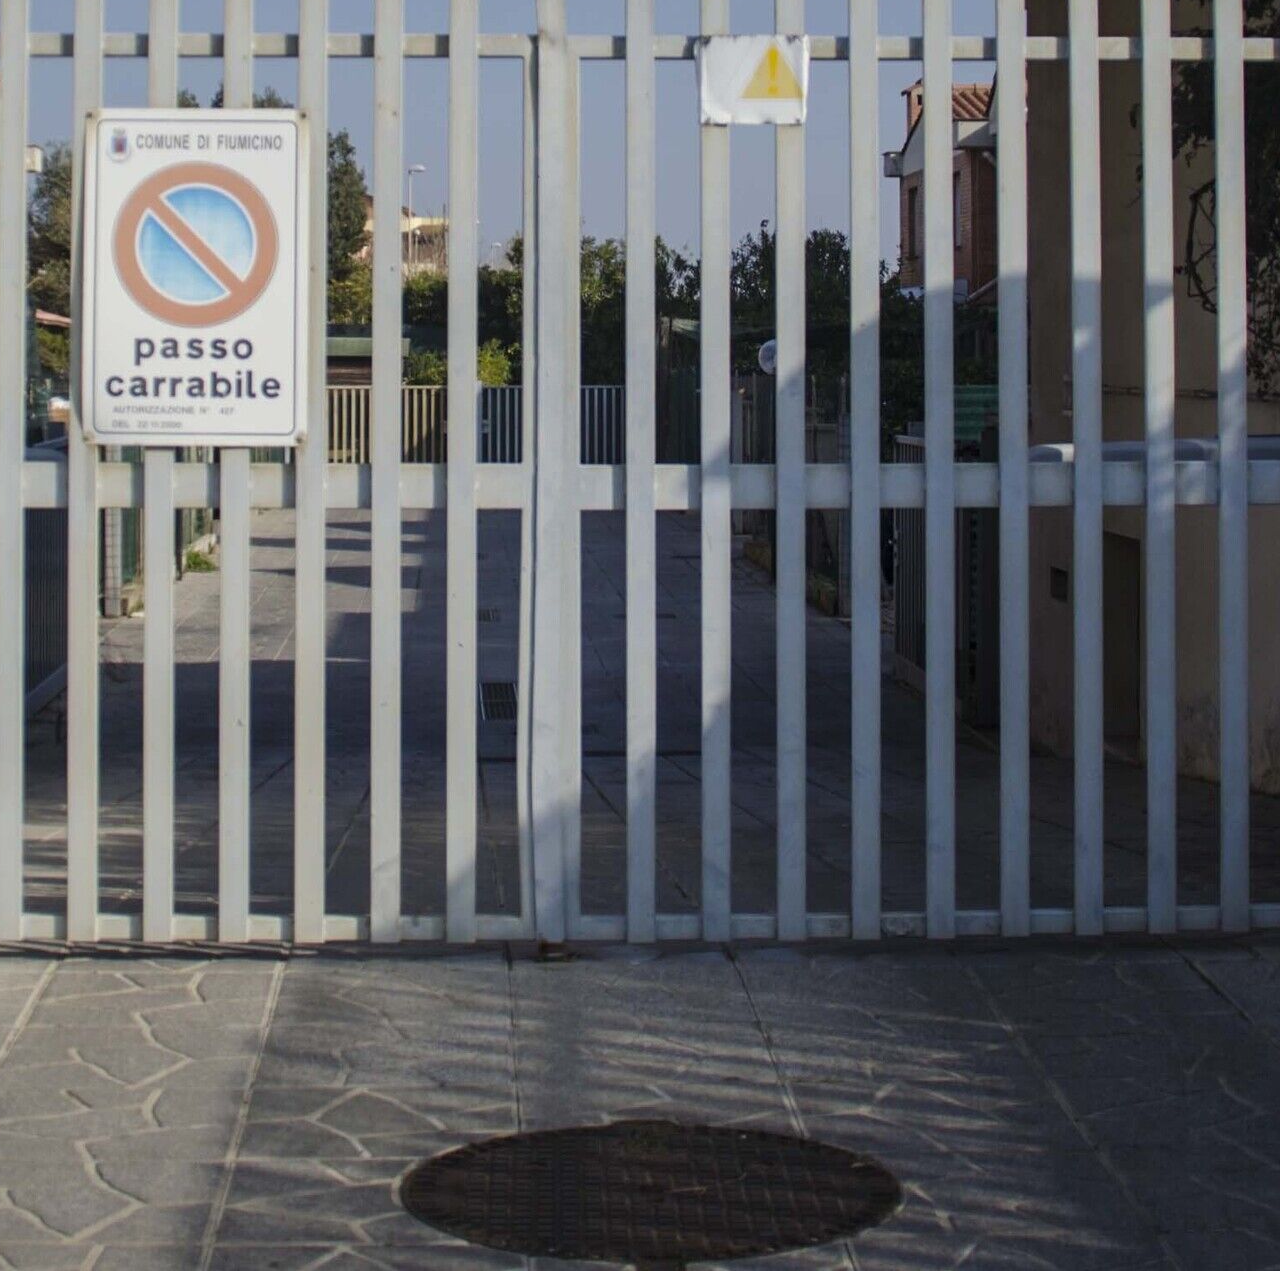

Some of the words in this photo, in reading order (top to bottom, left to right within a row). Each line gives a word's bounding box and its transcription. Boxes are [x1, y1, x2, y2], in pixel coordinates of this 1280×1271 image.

[136, 134, 190, 151] COMUNE
[197, 135, 210, 151] DI
[217, 135, 283, 152] FIUMICINO
[134, 337, 254, 367] passo
[105, 370, 281, 399] carrabile
[112, 405, 195, 415] AUTORIZZAZIONE
